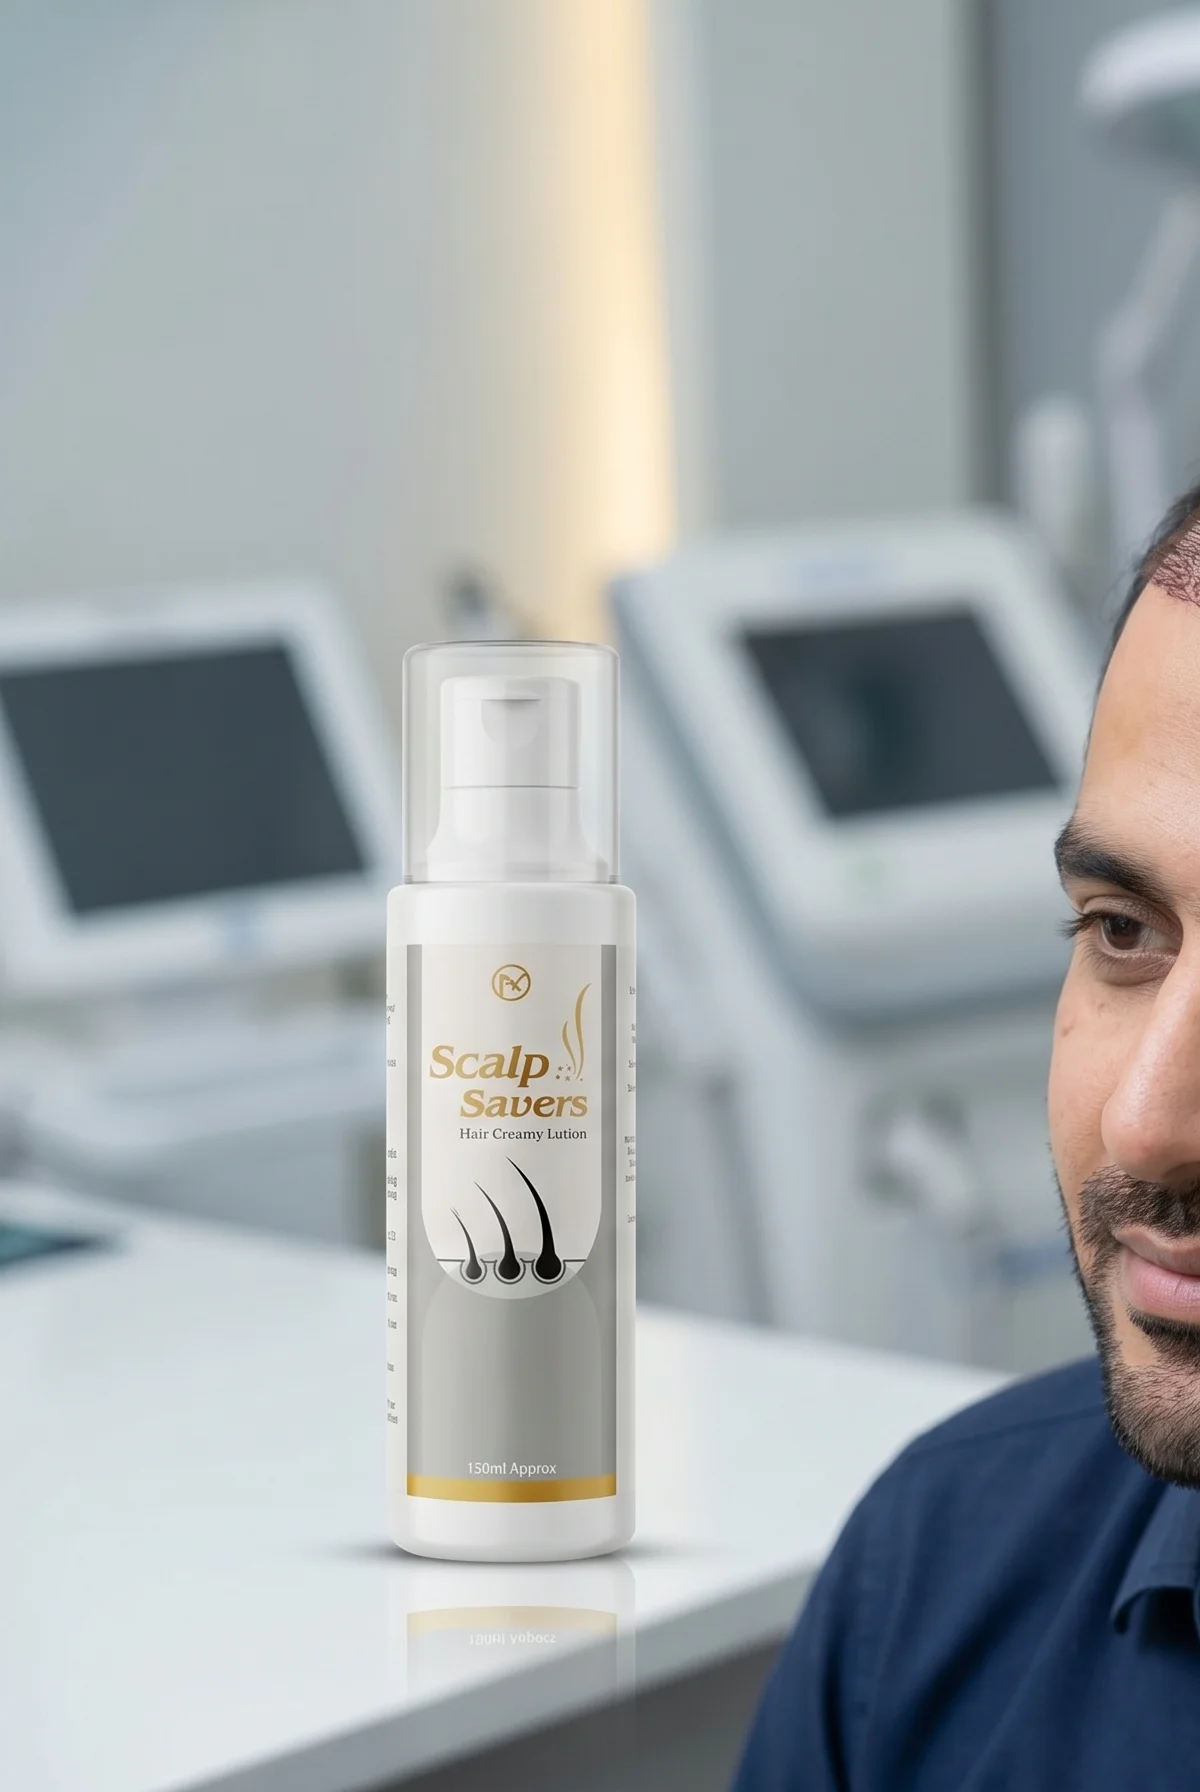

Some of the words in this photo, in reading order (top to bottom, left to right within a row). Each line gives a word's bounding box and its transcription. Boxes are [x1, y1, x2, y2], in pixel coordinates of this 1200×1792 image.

[429, 1045, 549, 1088] Scalp
[460, 1089, 588, 1118] Savers
[460, 1128, 489, 1139] Hair
[493, 1128, 544, 1142] Creamy
[548, 1128, 587, 1139] Lution
[509, 1462, 557, 1477] Approx
